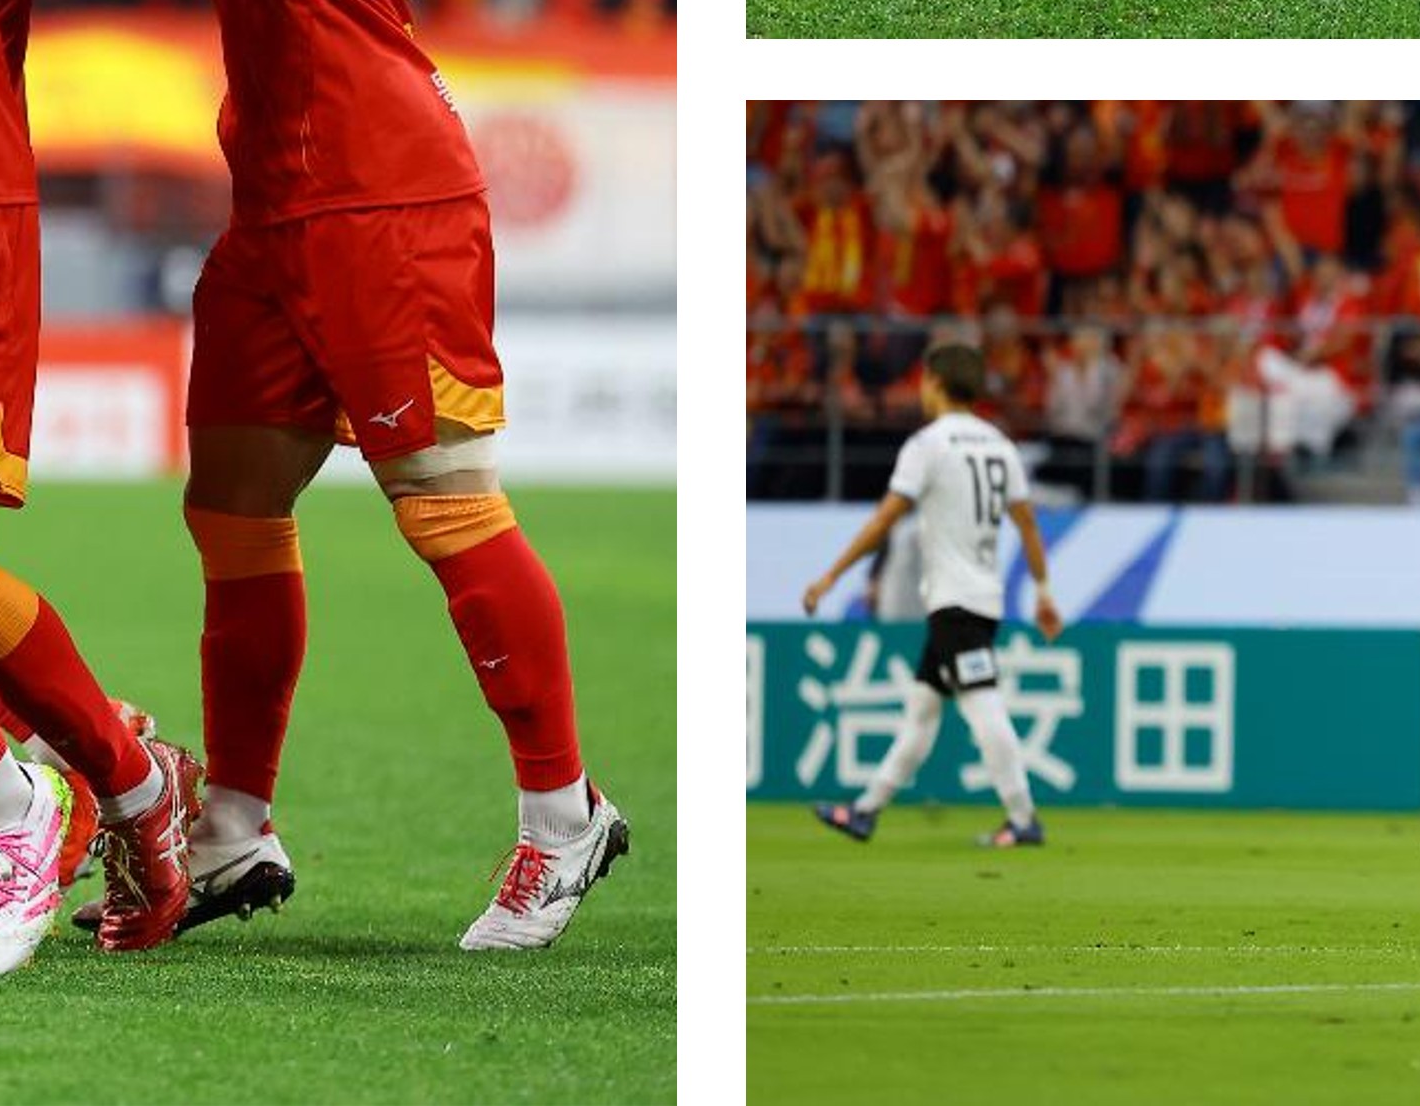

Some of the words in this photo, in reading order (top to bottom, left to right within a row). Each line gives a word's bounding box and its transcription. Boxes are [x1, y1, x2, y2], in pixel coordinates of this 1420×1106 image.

[966, 453, 1010, 526] 18
[746, 631, 1235, 792] 治安田
